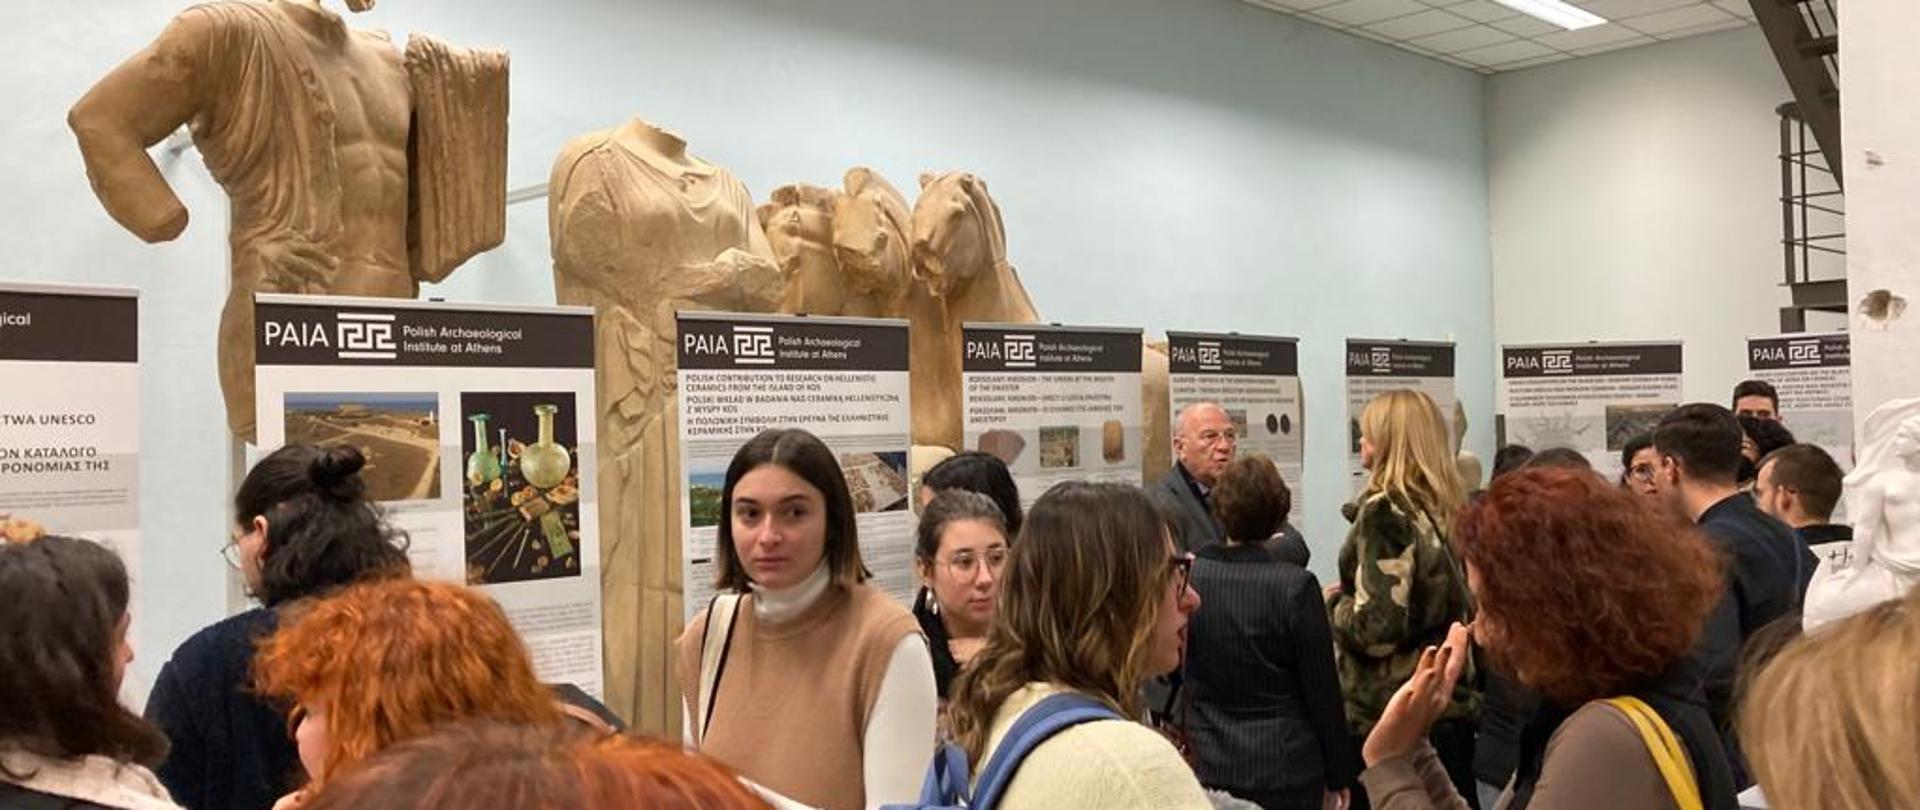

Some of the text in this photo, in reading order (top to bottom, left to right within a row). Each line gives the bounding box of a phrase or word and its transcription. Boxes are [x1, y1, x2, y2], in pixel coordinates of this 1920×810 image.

[265, 321, 329, 347] PAIA
[403, 325, 522, 342] Polish Archaeological
[403, 340, 502, 354] Institute at Athens
[684, 333, 729, 355] PAIA
[778, 335, 860, 350] Polish Archaeological
[779, 349, 847, 360] Institute at Athens
[967, 341, 1001, 360] PAIA
[1171, 346, 1197, 363] PAIA
[1753, 347, 1785, 360] PAIA
[1349, 352, 1370, 367] PAIA
[1507, 356, 1539, 369] PAIA
[686, 374, 877, 382] POLISH CONTRIBUTION TO RESEARCH ON HELLENISTIC
[686, 383, 821, 392] CERAMICS FROM THE ISLAND OF KOS
[40, 414, 96, 425] UNESCO
